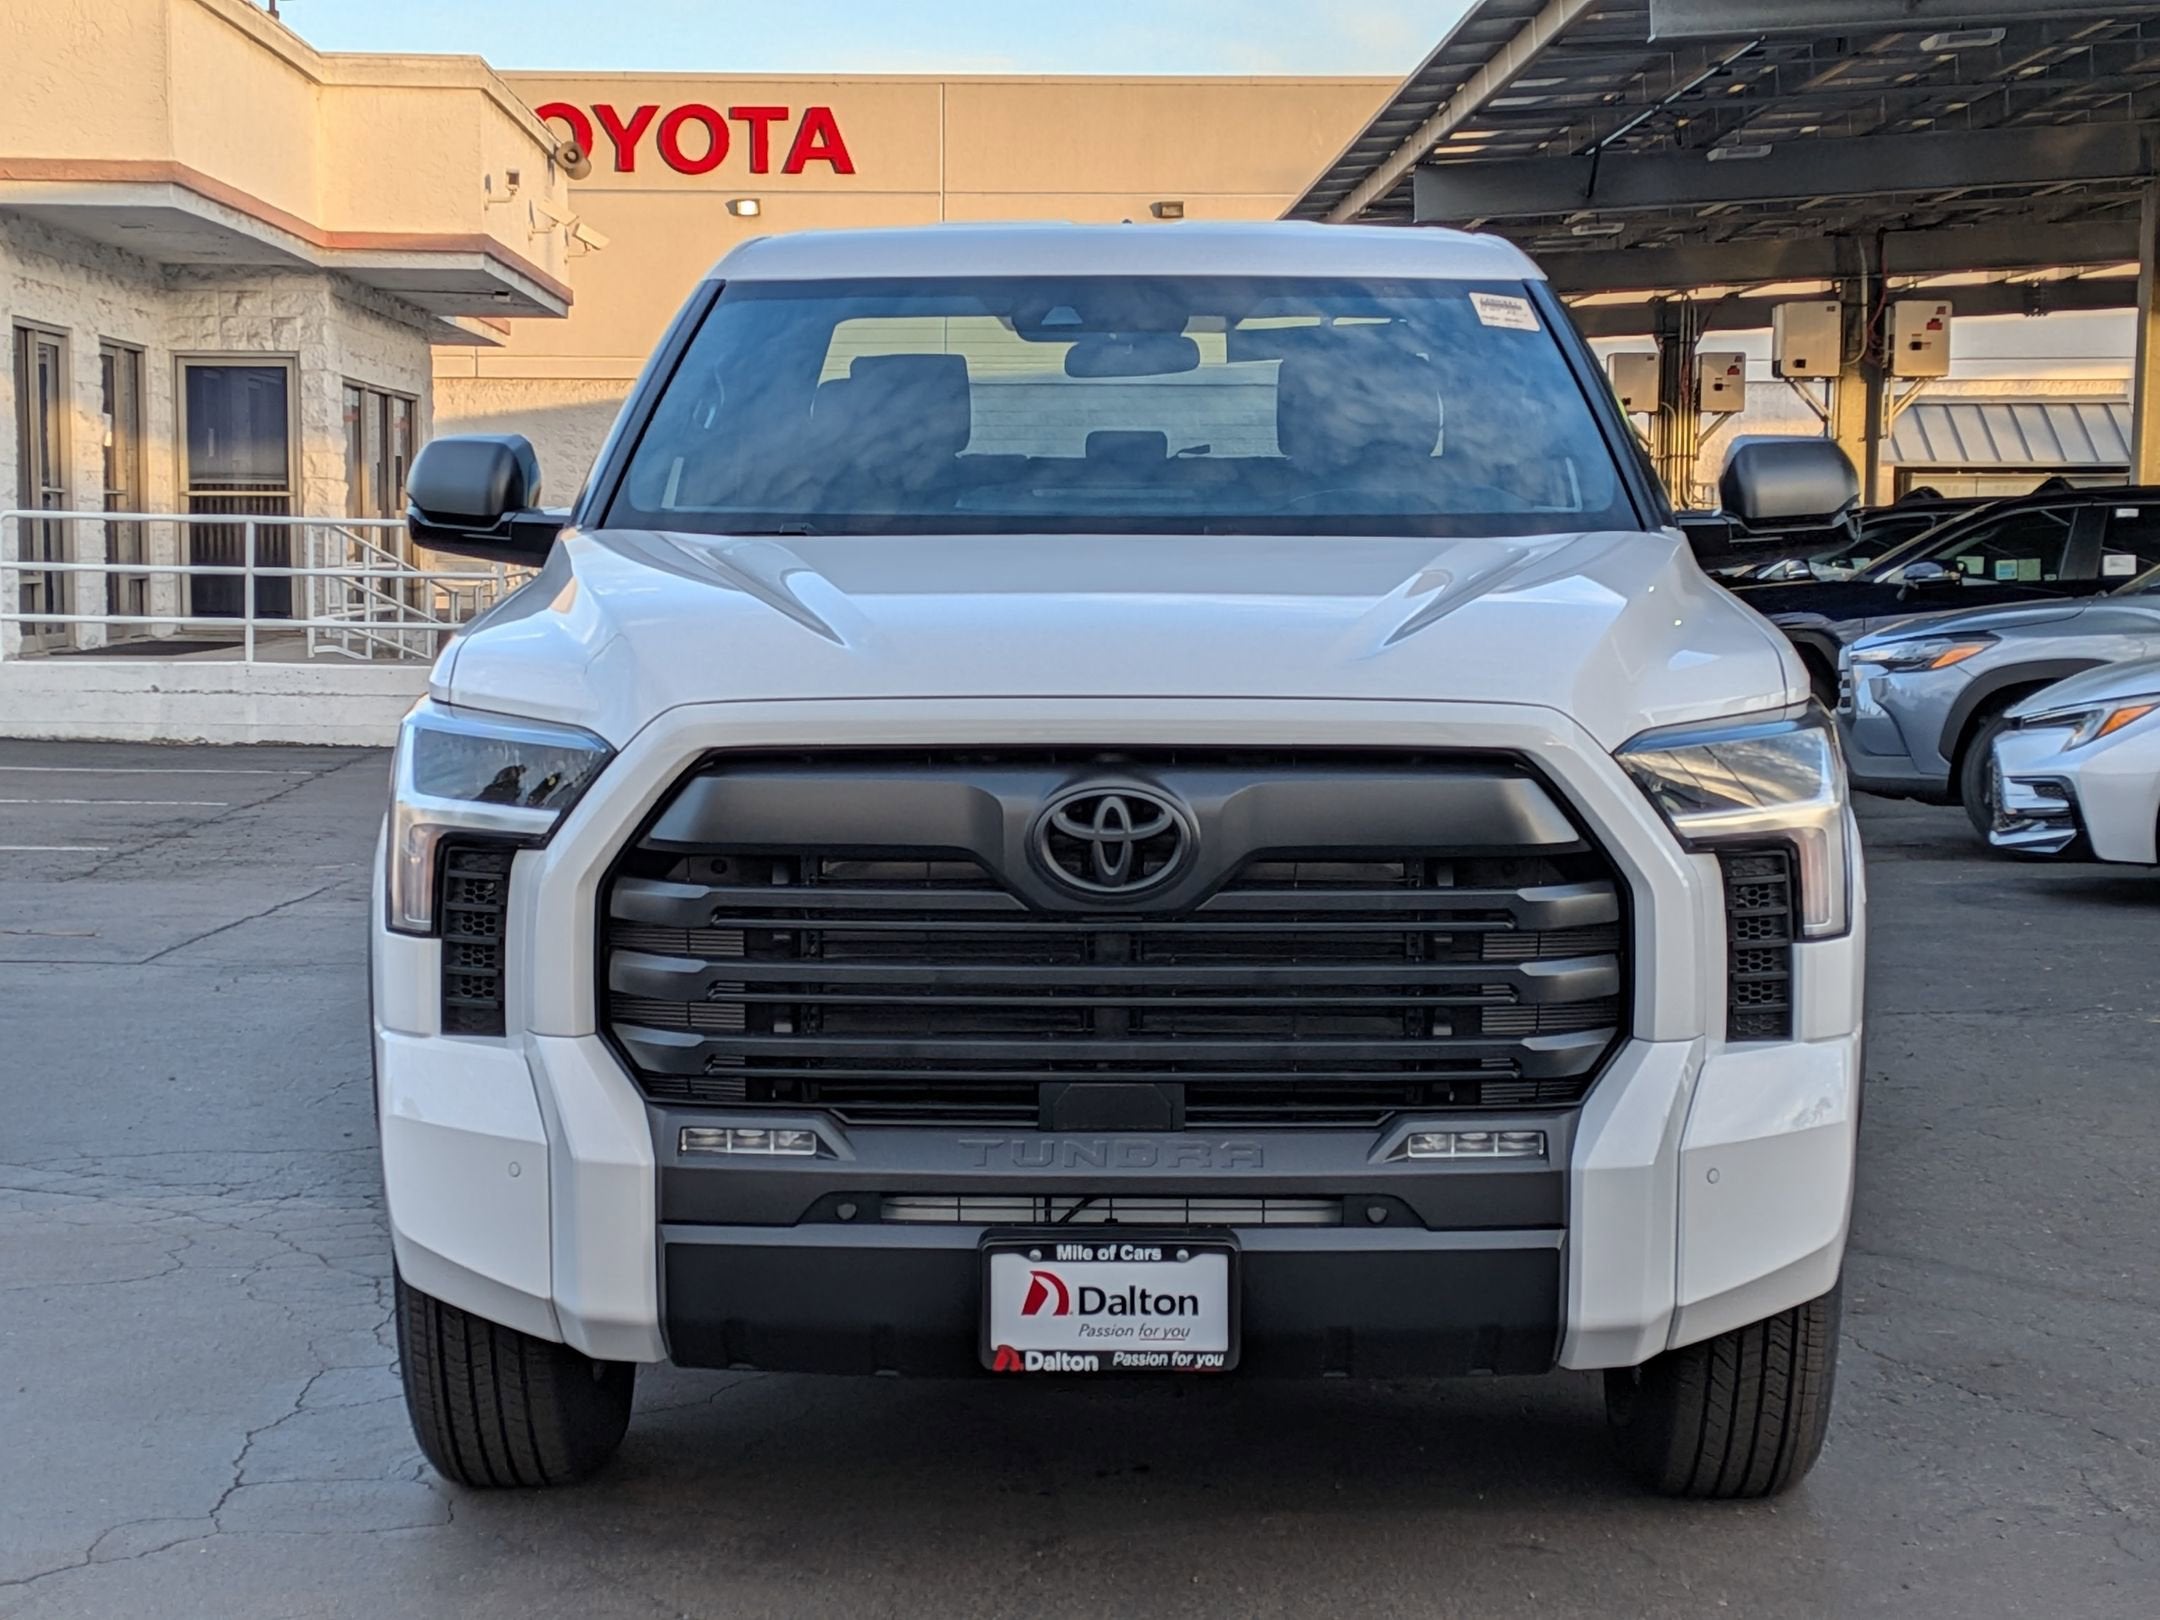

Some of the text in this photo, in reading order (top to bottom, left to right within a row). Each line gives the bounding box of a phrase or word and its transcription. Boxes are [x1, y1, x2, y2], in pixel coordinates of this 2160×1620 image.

[958, 1139, 1265, 1169] TUNDRA
[1056, 1244, 1162, 1261] Mile of Cars
[1078, 1285, 1199, 1316] Dalton
[1078, 1322, 1191, 1340] Passion for you
[1025, 1351, 1225, 1372] Dalton Passion for you
